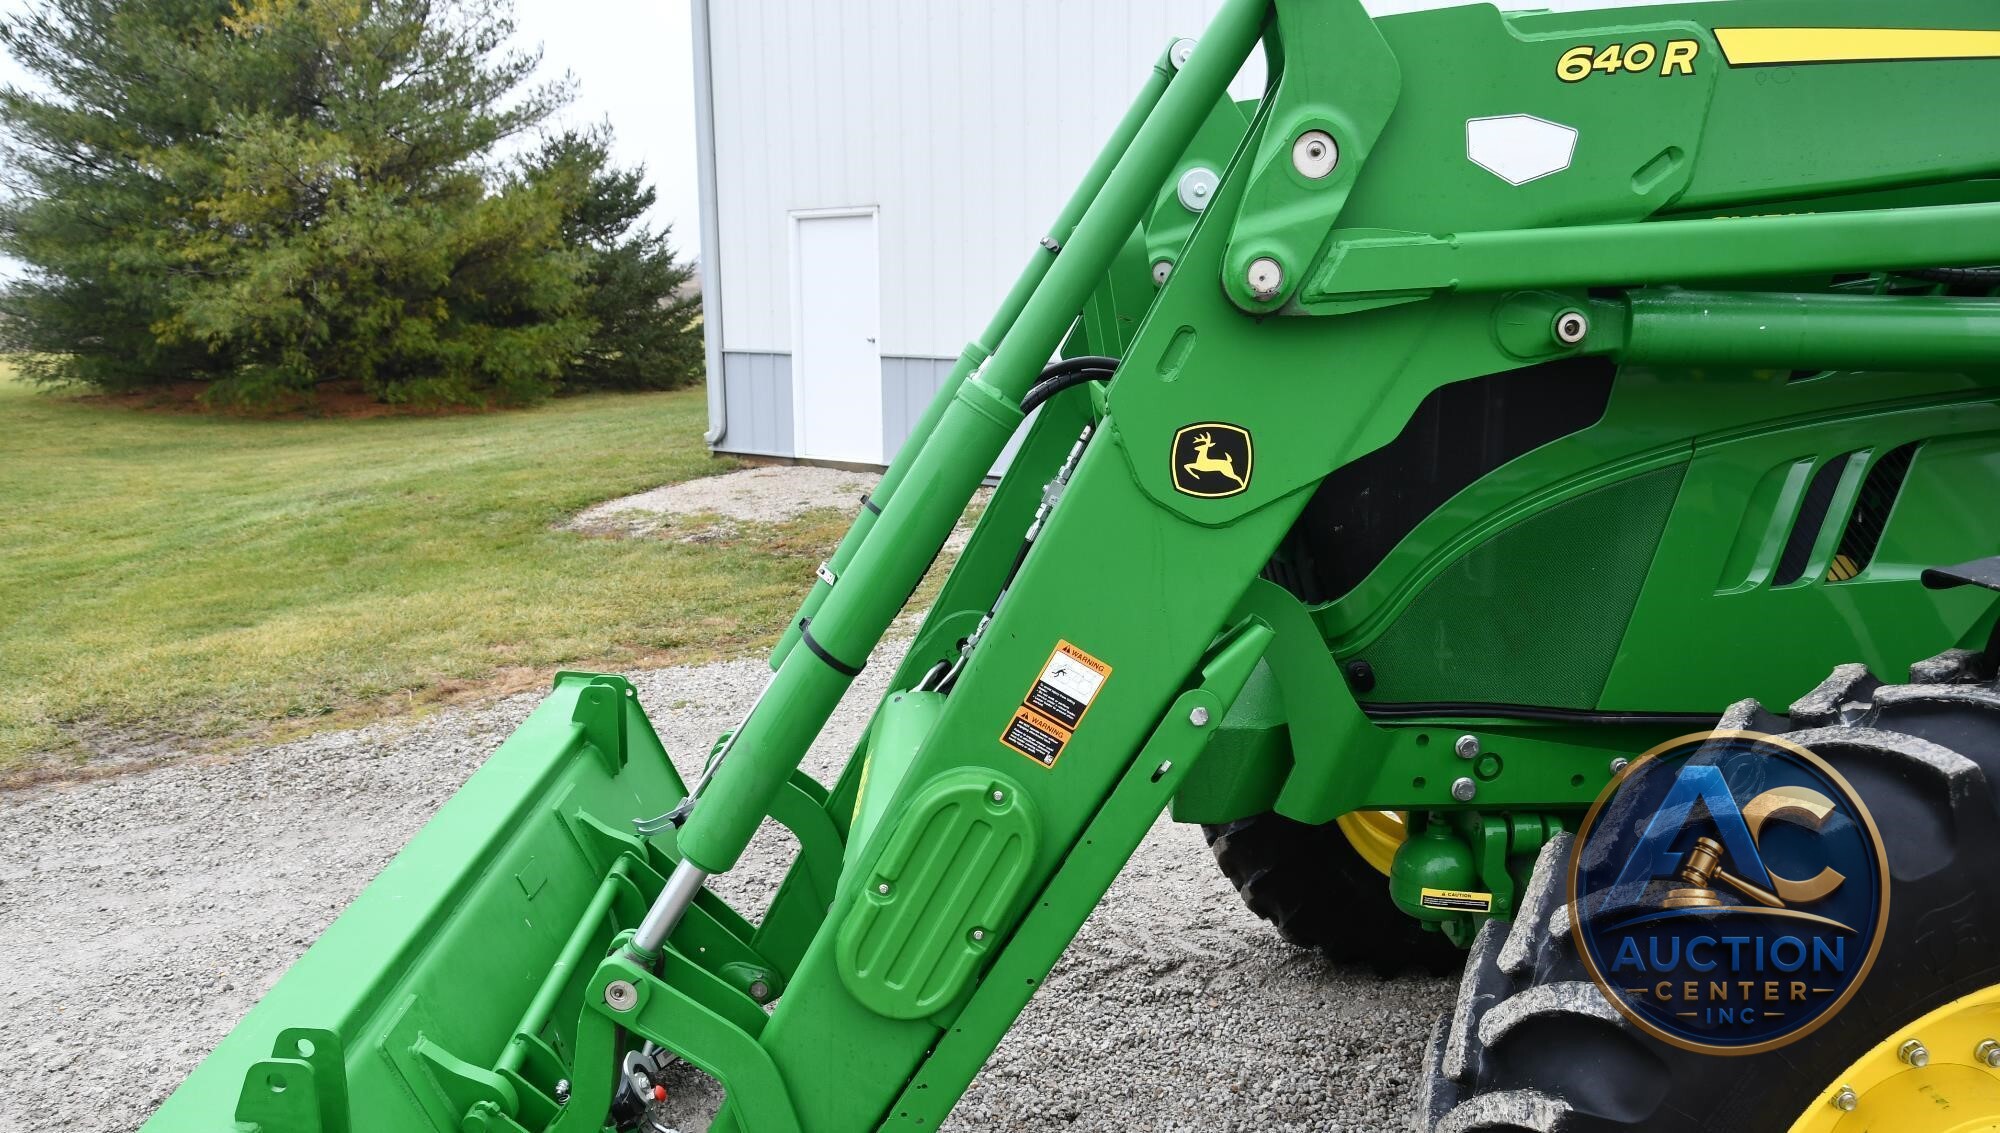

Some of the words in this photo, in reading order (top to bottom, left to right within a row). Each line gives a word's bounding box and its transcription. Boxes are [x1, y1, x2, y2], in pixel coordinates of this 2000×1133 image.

[1556, 42, 1657, 83] 640
[1659, 39, 1700, 77] R
[1071, 649, 1105, 672] WARNING
[1031, 716, 1064, 739] WARNING
